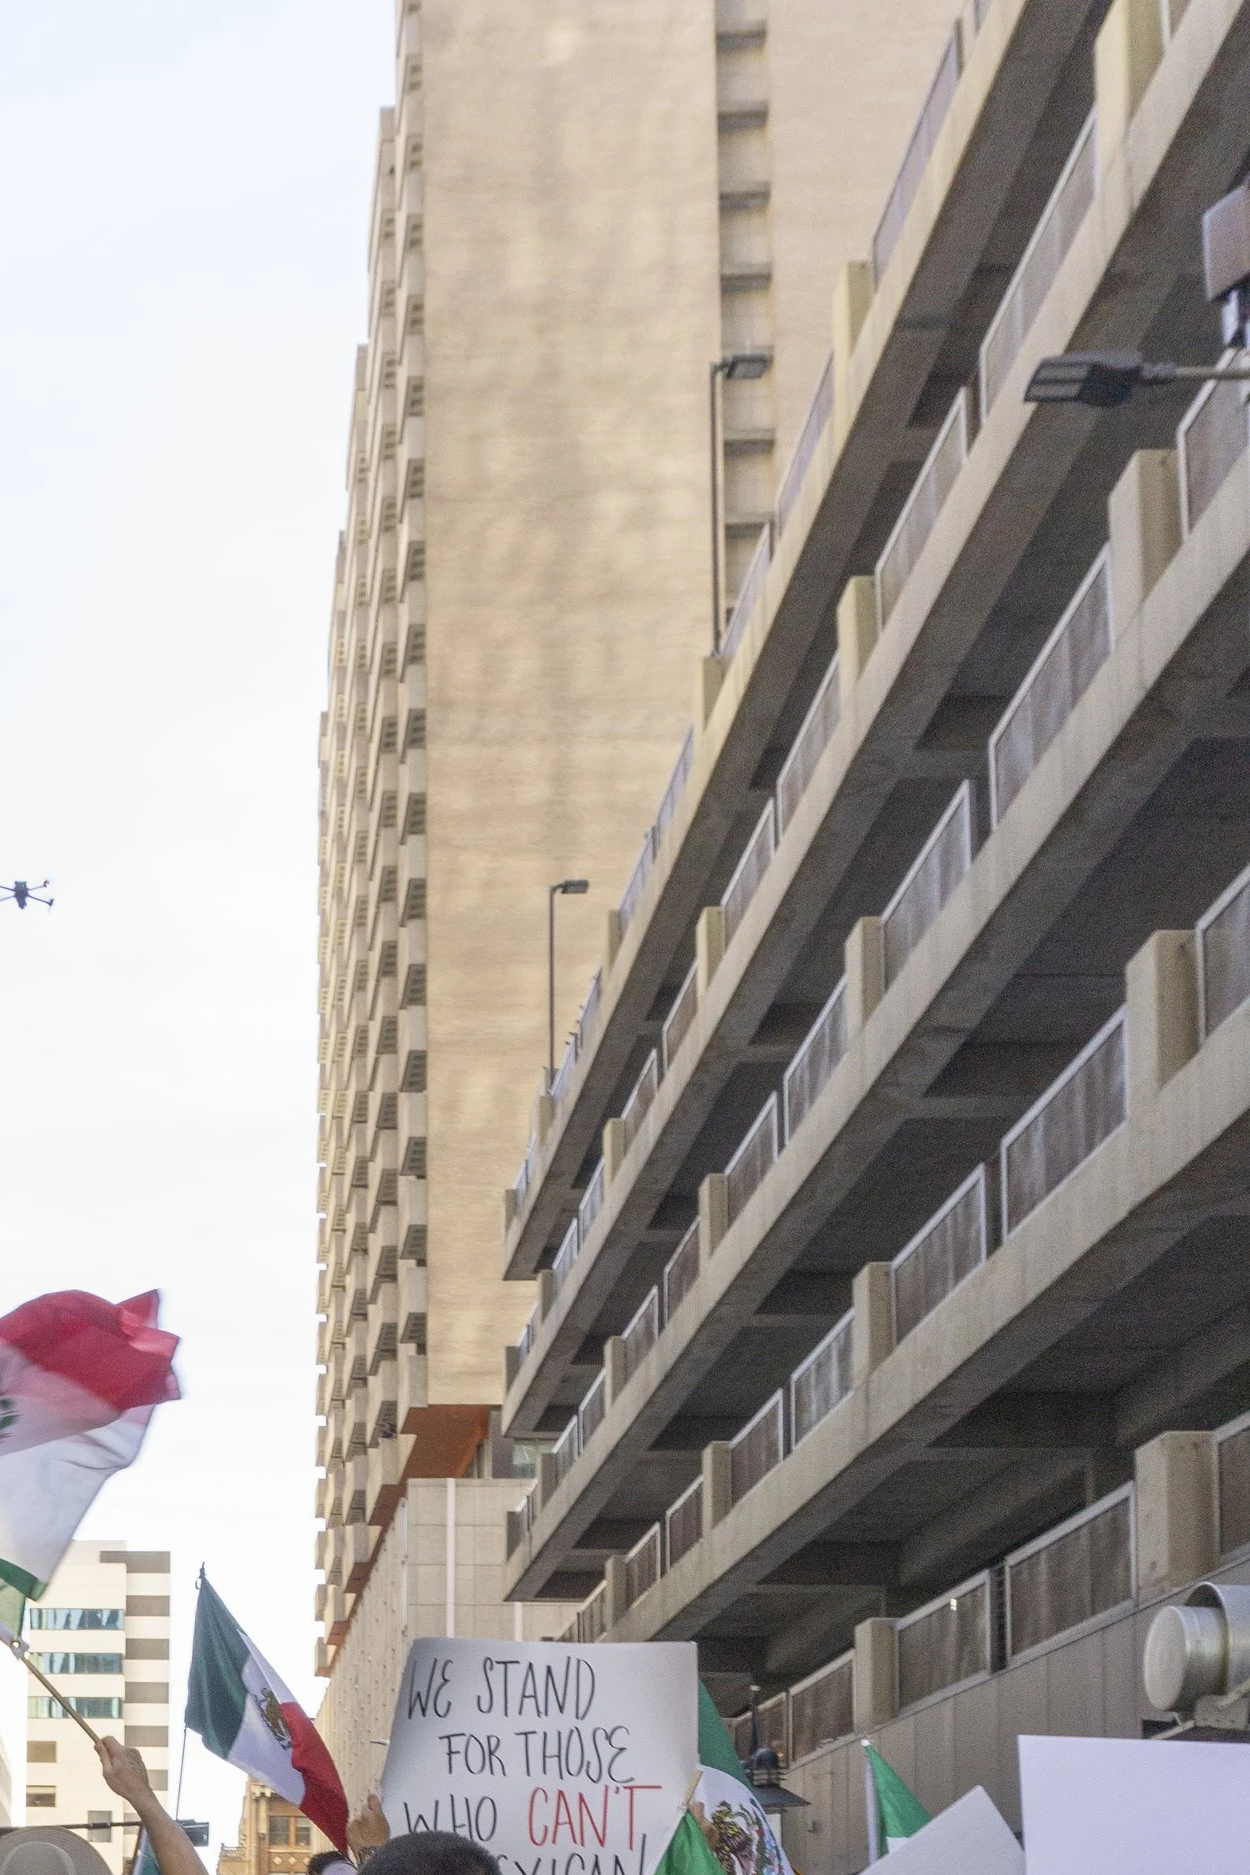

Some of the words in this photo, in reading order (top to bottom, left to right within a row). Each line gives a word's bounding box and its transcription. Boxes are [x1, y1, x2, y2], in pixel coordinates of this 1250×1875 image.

[407, 1657, 453, 1720] WE
[476, 1655, 596, 1720] STAND
[438, 1732, 506, 1777] FOR
[514, 1725, 634, 1784] THOSE
[403, 1793, 498, 1842] WHO
[528, 1784, 663, 1851] CAN'T
